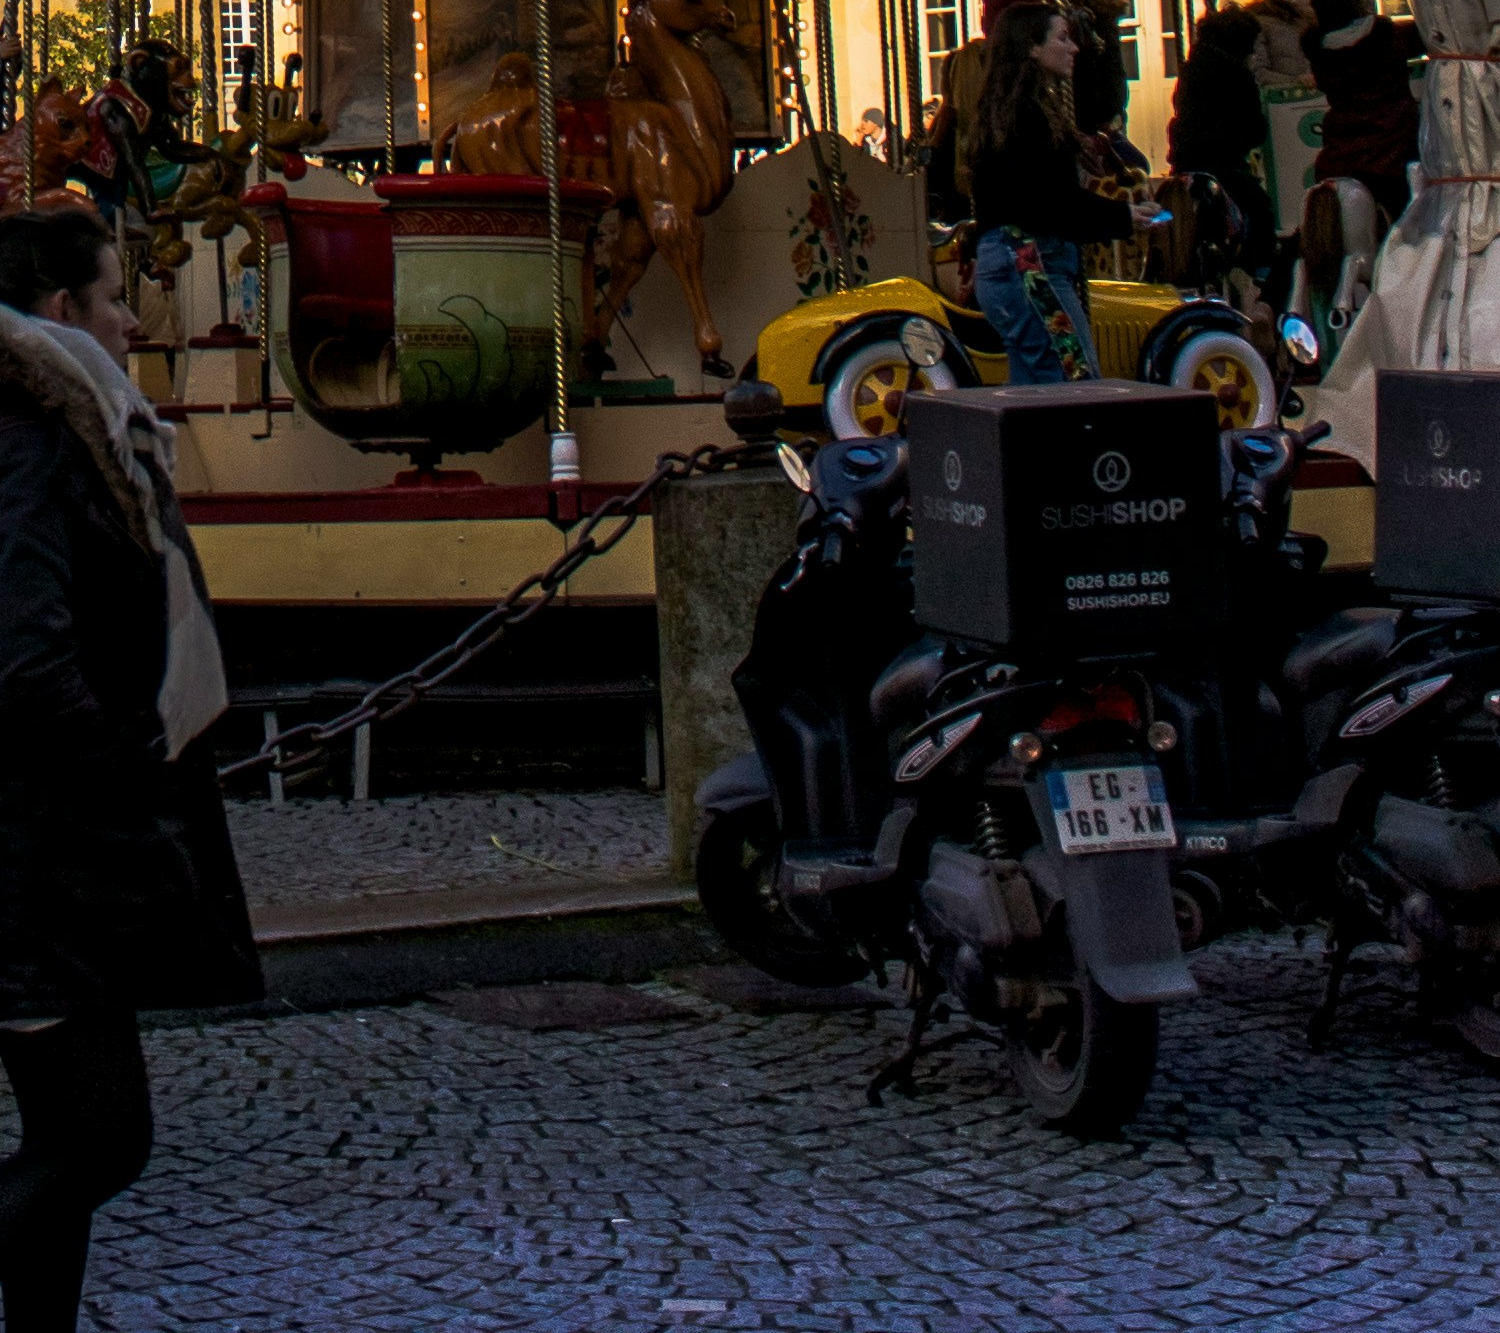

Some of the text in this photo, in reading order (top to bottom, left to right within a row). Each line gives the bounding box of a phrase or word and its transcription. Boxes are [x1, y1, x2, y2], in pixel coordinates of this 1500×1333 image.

[1041, 497, 1187, 531] SUSHISHOP
[1065, 569, 1169, 591] 0826 826 826
[1066, 591, 1171, 612] SUSHISHOP.EU
